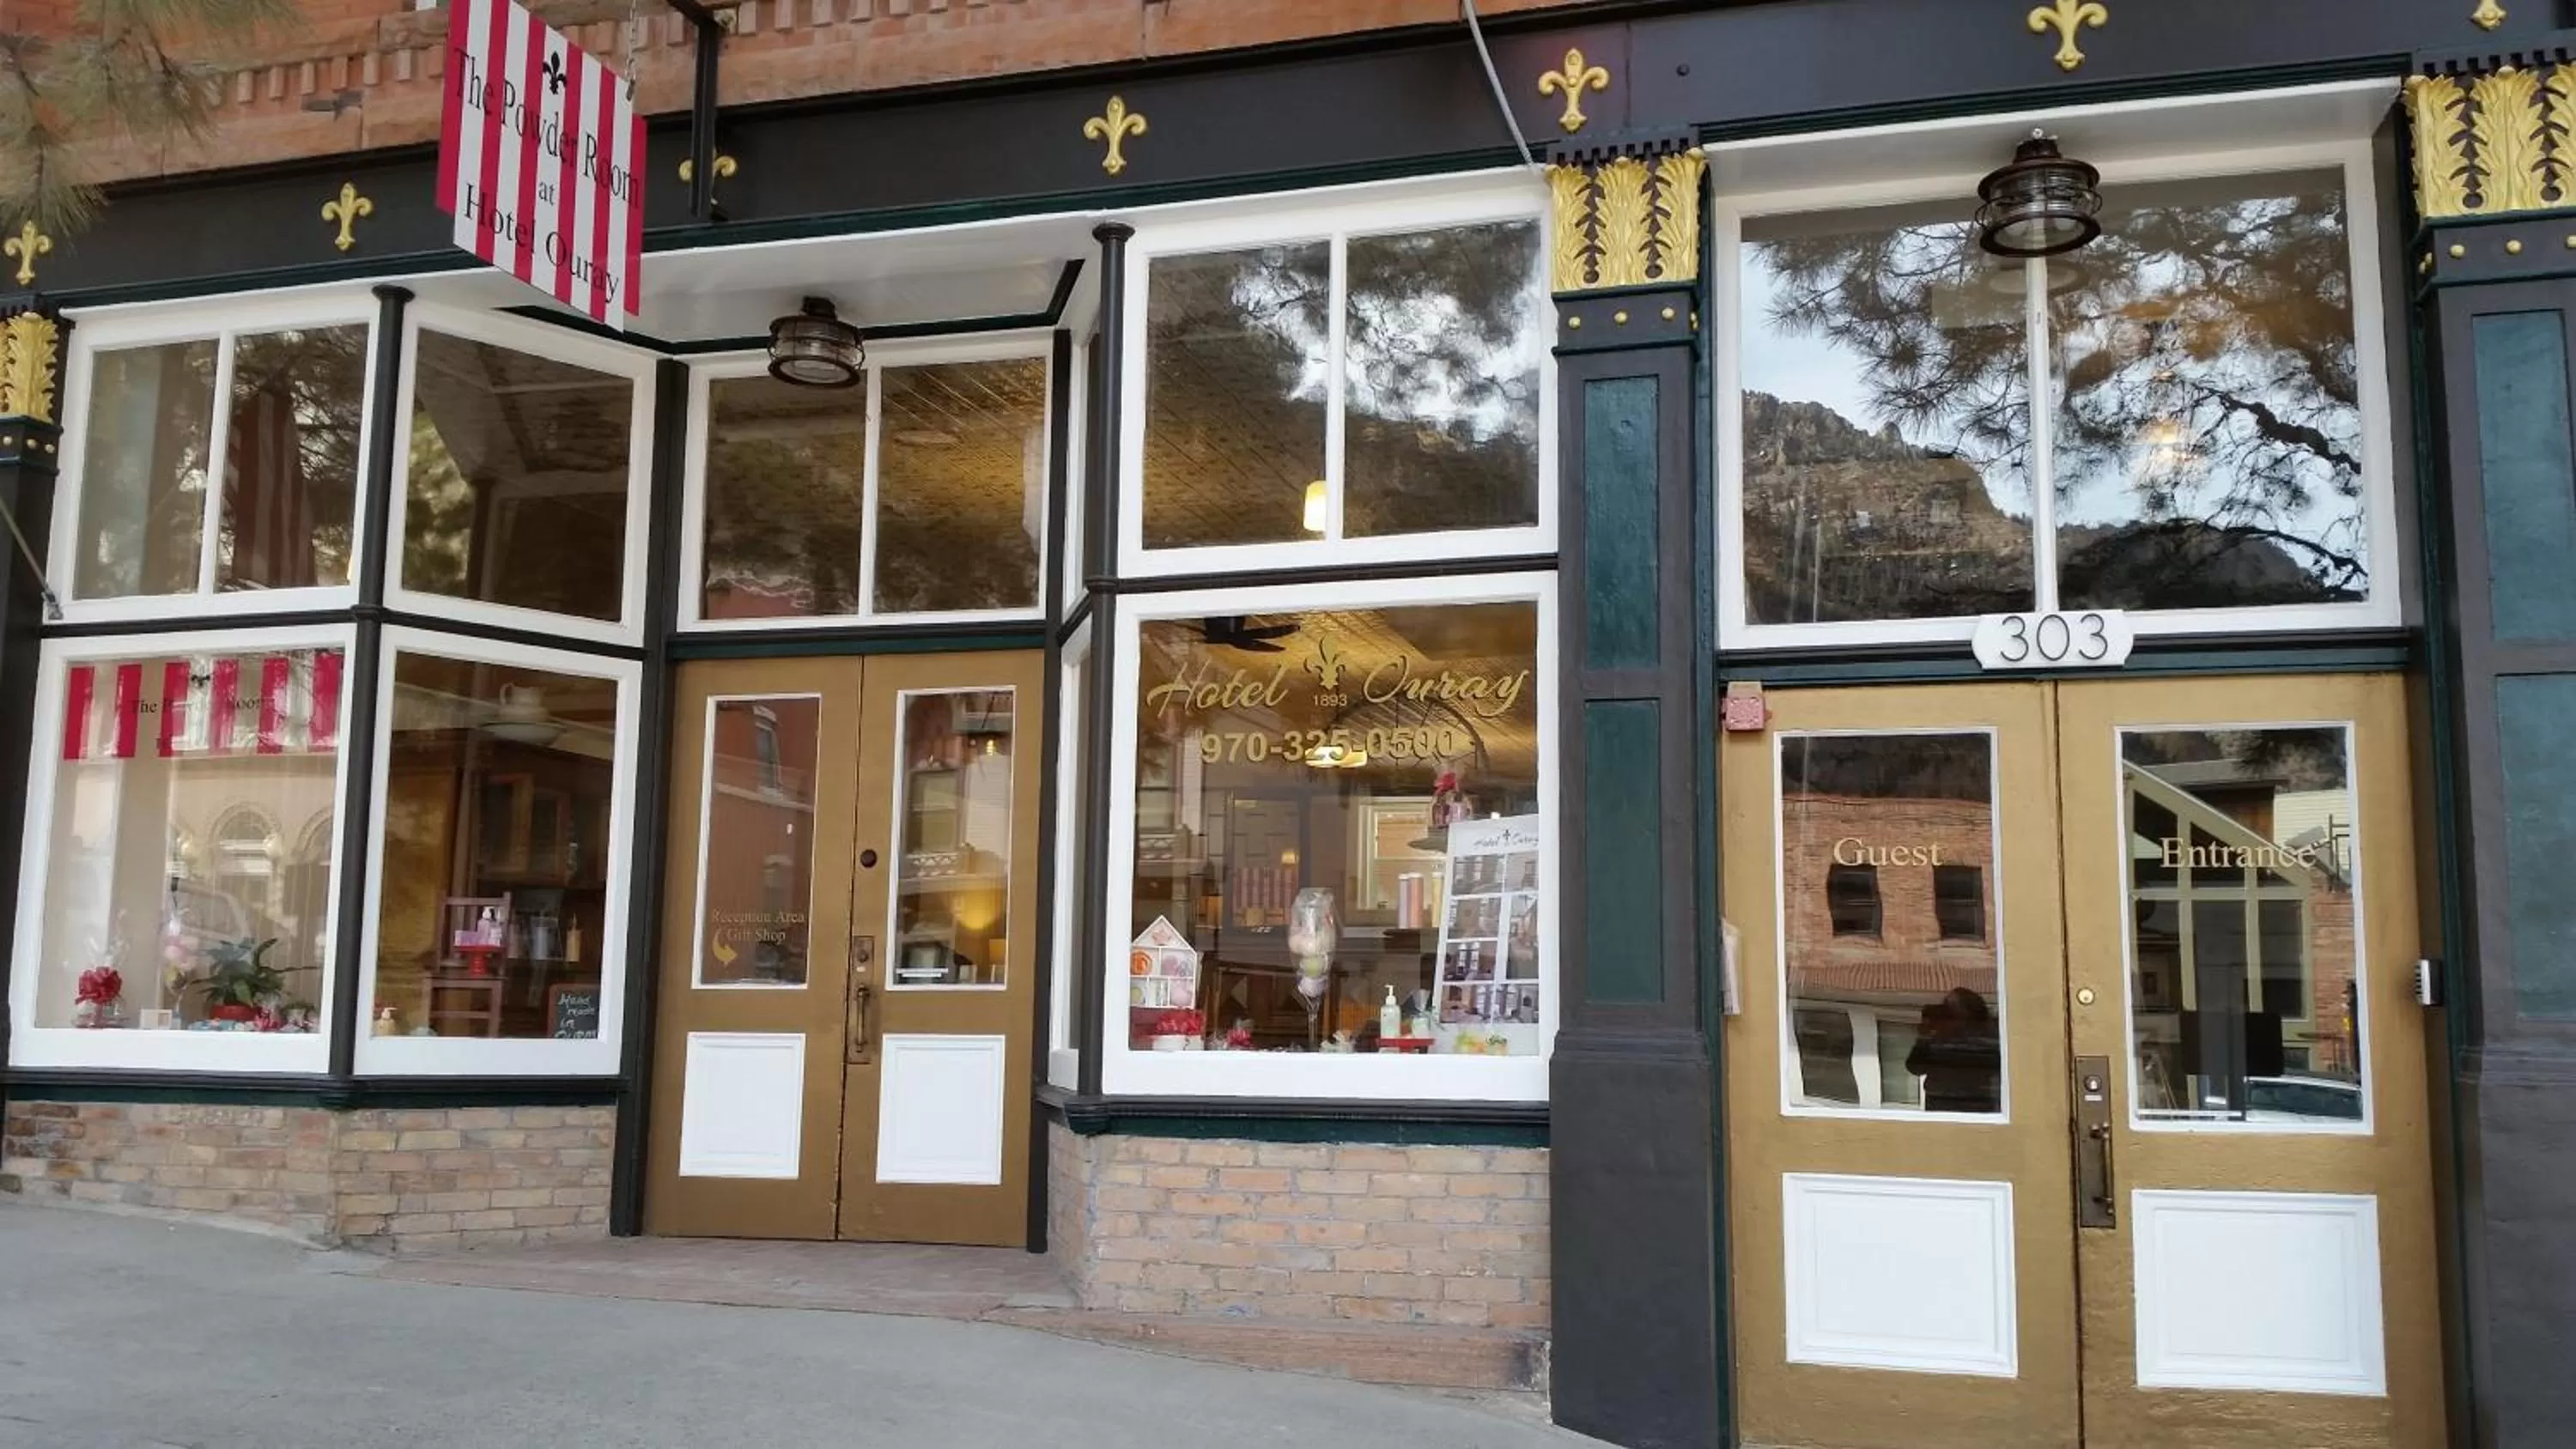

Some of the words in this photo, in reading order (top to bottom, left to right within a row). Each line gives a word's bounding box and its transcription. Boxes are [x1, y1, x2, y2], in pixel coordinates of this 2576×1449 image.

[454, 47, 493, 115] The
[501, 81, 577, 167] Powder
[585, 132, 640, 209] Room
[538, 179, 555, 206] at
[465, 182, 536, 252] Hotel
[545, 230, 618, 304] Ouray
[2000, 613, 2109, 662] 303
[1145, 658, 1290, 720] Hotel
[1363, 655, 1530, 718] Ouray
[1313, 693, 1348, 707] 1893
[1201, 727, 1455, 764] 970-325-0500
[1833, 837, 1944, 866] Guest
[2160, 837, 2318, 869] Entrance
[775, 910, 805, 923] Area
[726, 928, 752, 942] Gift
[756, 929, 786, 945] Shop
